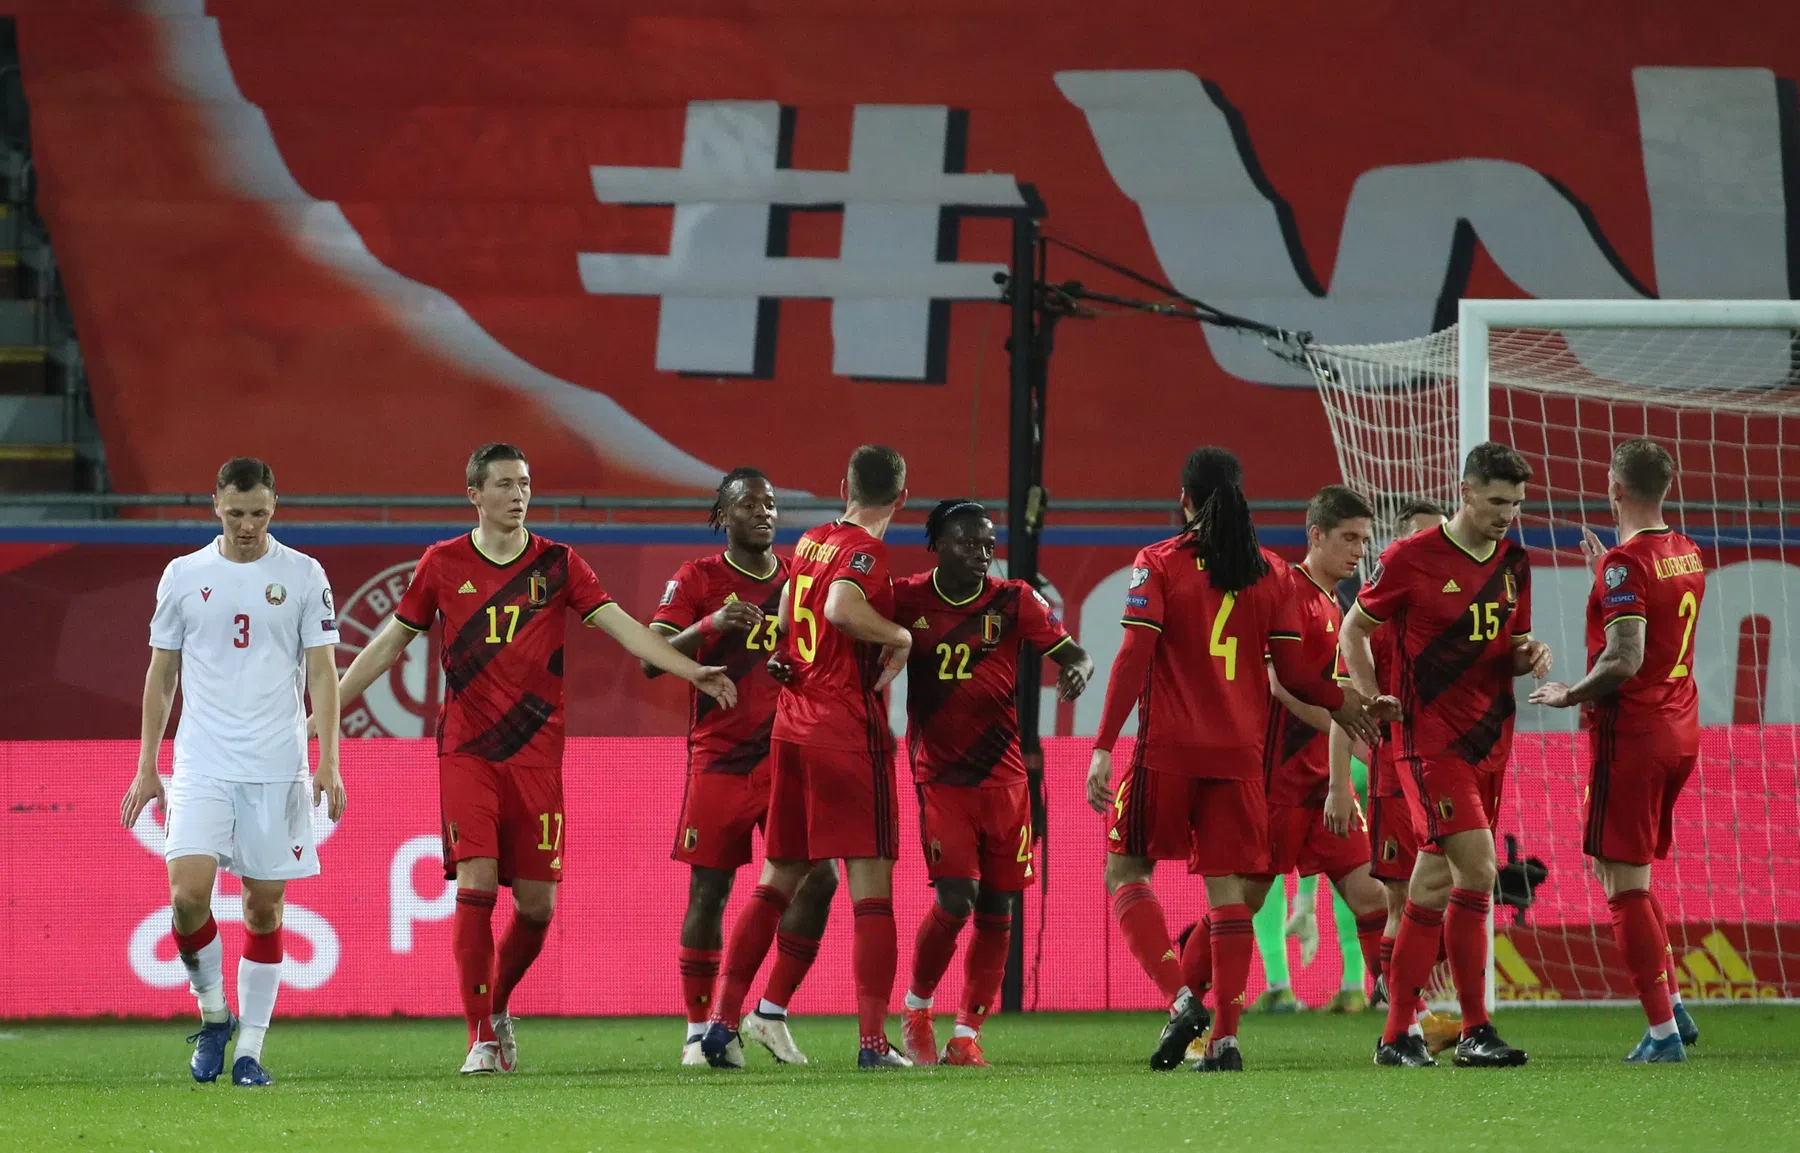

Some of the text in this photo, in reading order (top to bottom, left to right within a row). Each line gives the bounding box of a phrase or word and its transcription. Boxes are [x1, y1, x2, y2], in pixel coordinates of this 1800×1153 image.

[233, 613, 250, 649] 3
[485, 605, 520, 643] 17
[746, 615, 779, 651] 23
[794, 574, 817, 663] 5
[1209, 590, 1238, 680] 4
[1469, 602, 1500, 641] 15
[1668, 591, 1697, 678] 2
[936, 643, 972, 680] 22
[538, 813, 563, 850] 17
